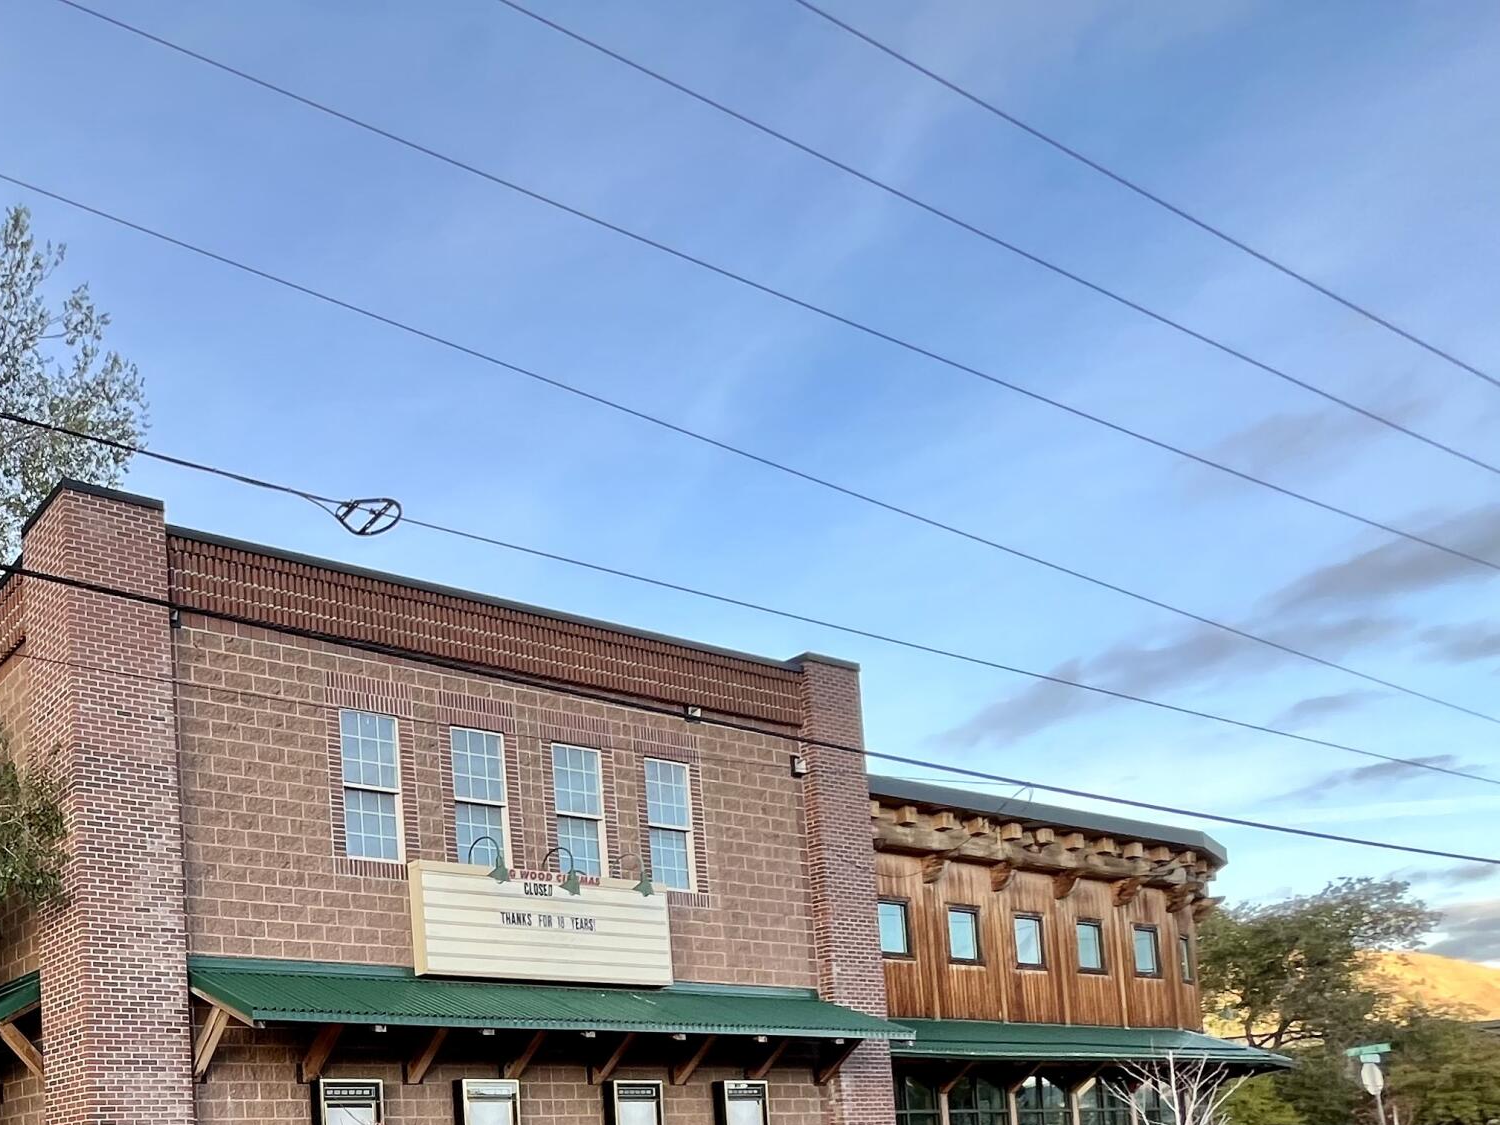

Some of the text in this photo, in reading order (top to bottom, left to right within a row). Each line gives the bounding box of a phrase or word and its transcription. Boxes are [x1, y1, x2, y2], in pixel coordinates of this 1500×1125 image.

[520, 870, 553, 881] WOOD
[556, 874, 600, 887] CIMAS
[524, 882, 553, 897] CLOSED
[500, 911, 532, 927] THANKS
[538, 914, 553, 929] FOR
[570, 916, 597, 932] YEARS!
